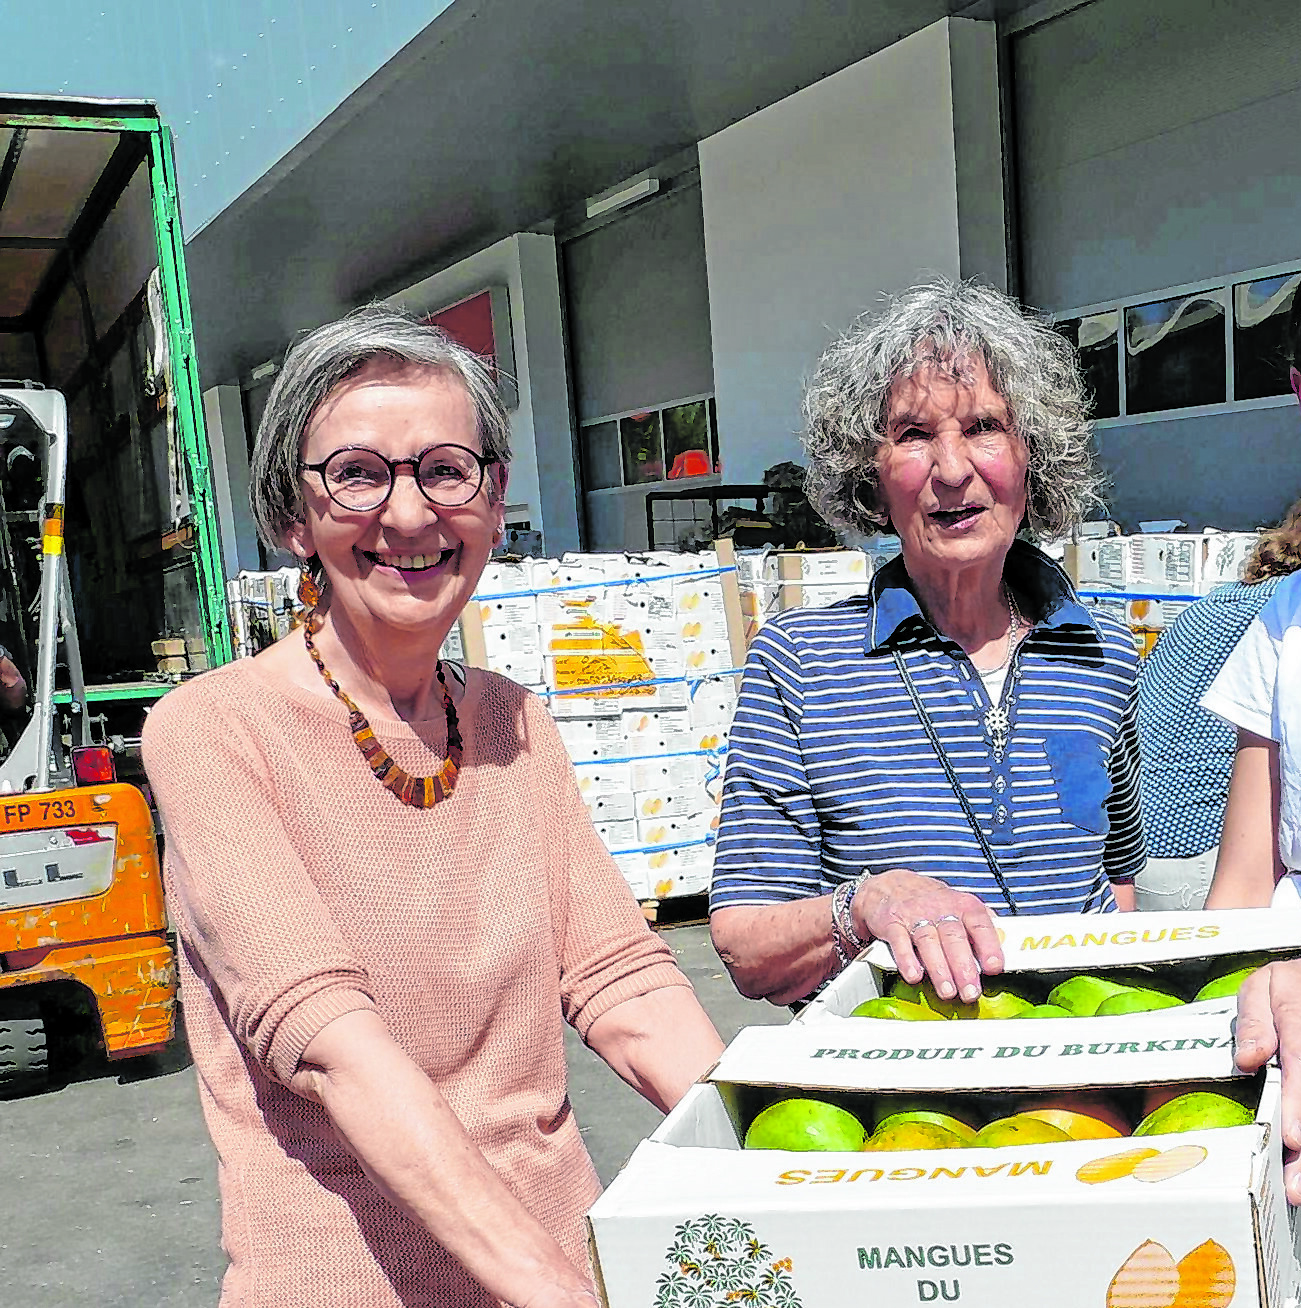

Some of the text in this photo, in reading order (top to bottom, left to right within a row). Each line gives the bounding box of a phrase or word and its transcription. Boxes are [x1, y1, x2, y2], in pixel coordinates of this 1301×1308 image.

[4, 800, 76, 825] FP 733
[1020, 925, 1221, 951] MANGUES
[810, 1046, 985, 1061] PRODUIT
[991, 1045, 1051, 1060] DU
[775, 1160, 1054, 1185] MANGUES
[856, 1242, 1014, 1270] MANGUES
[917, 1279, 961, 1302] DU
